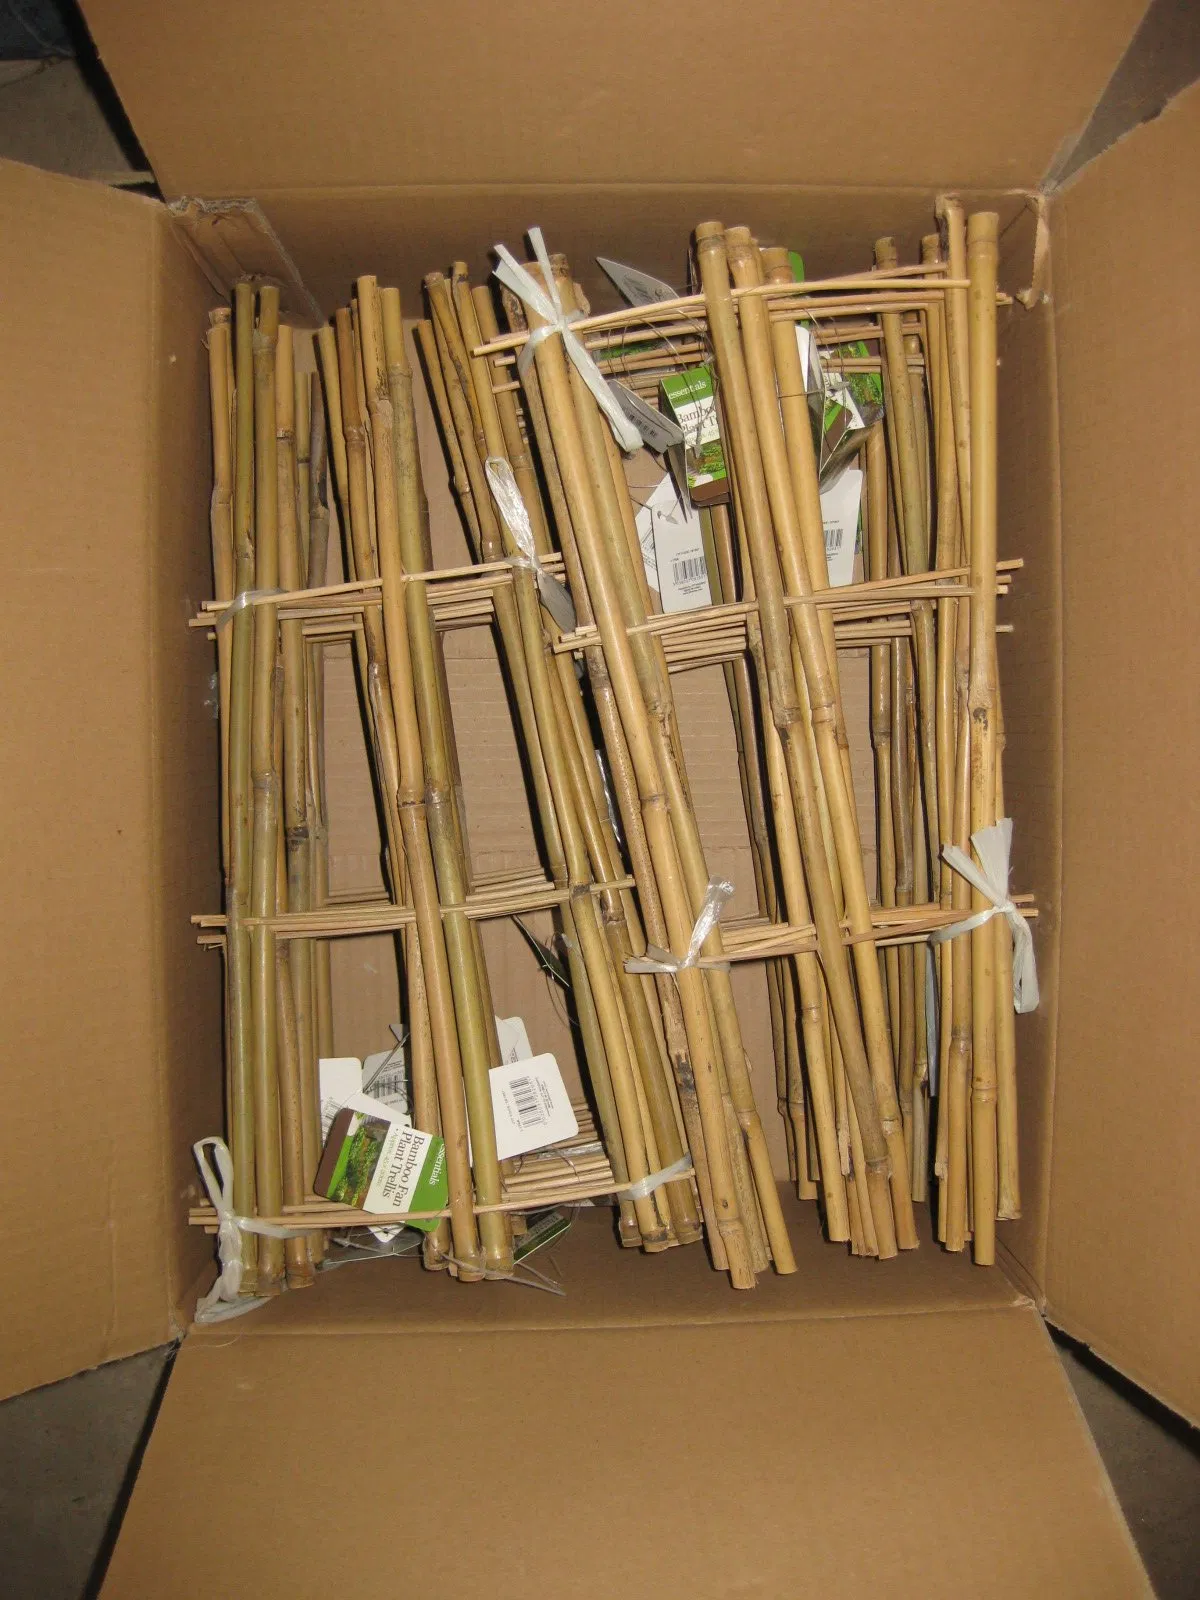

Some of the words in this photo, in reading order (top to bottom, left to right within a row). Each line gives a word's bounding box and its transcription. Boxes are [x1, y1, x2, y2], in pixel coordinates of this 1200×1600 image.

[393, 1131, 413, 1160] Plant
[405, 1135, 425, 1183] Bamboo
[382, 1163, 403, 1198] Trellis
[392, 1184, 409, 1207] Fan
